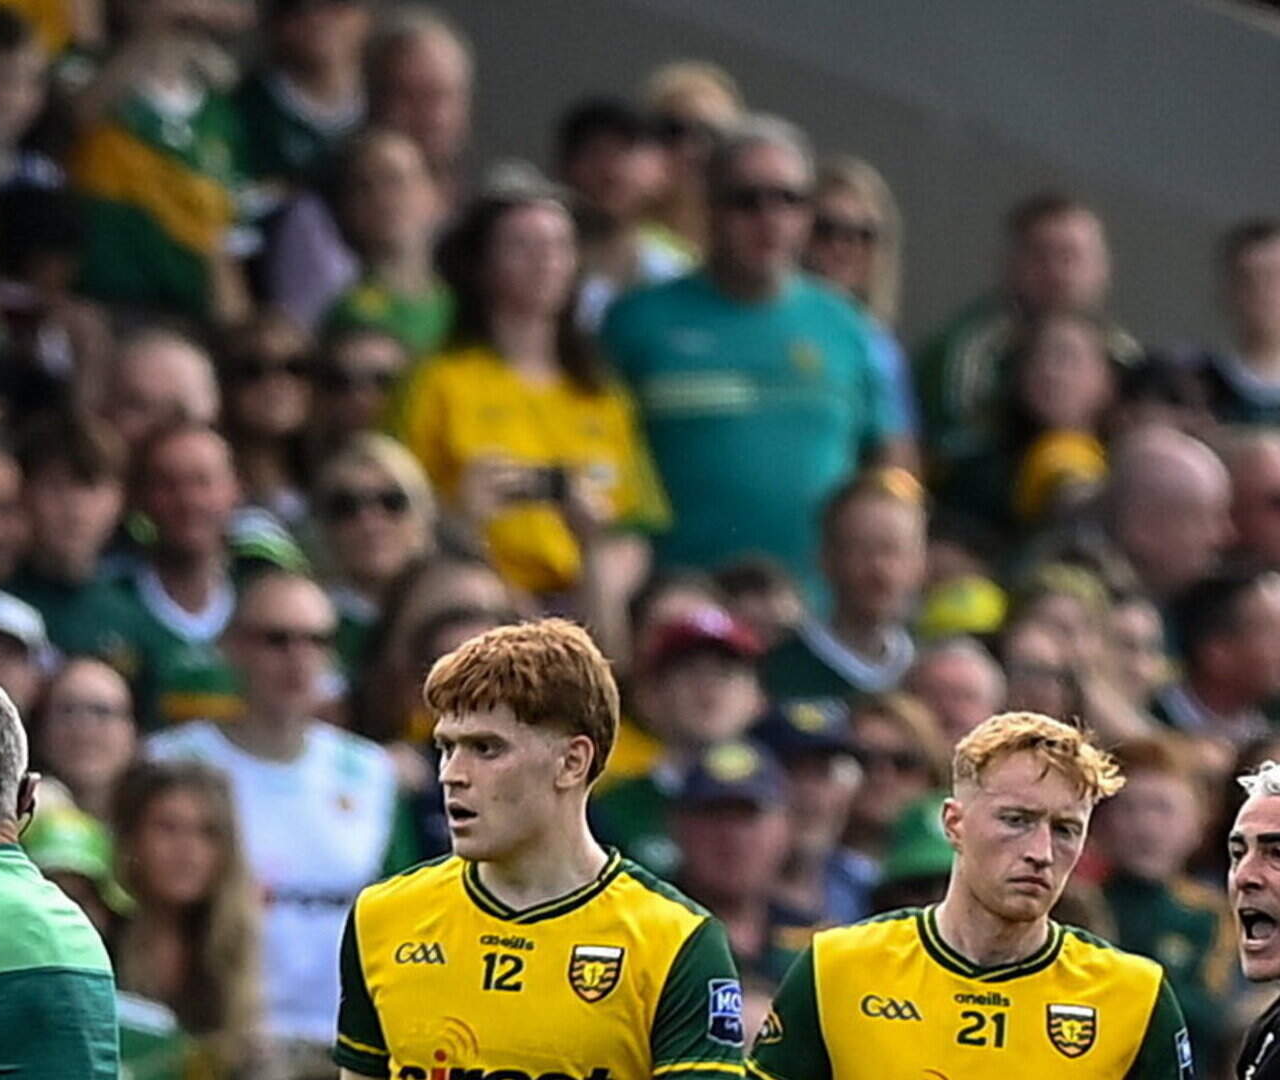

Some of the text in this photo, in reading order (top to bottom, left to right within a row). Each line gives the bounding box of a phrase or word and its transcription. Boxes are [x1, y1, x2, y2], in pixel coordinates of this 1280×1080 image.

[482, 952, 523, 992] 12
[954, 992, 1010, 1007] oneills
[957, 1011, 1005, 1048] 21
